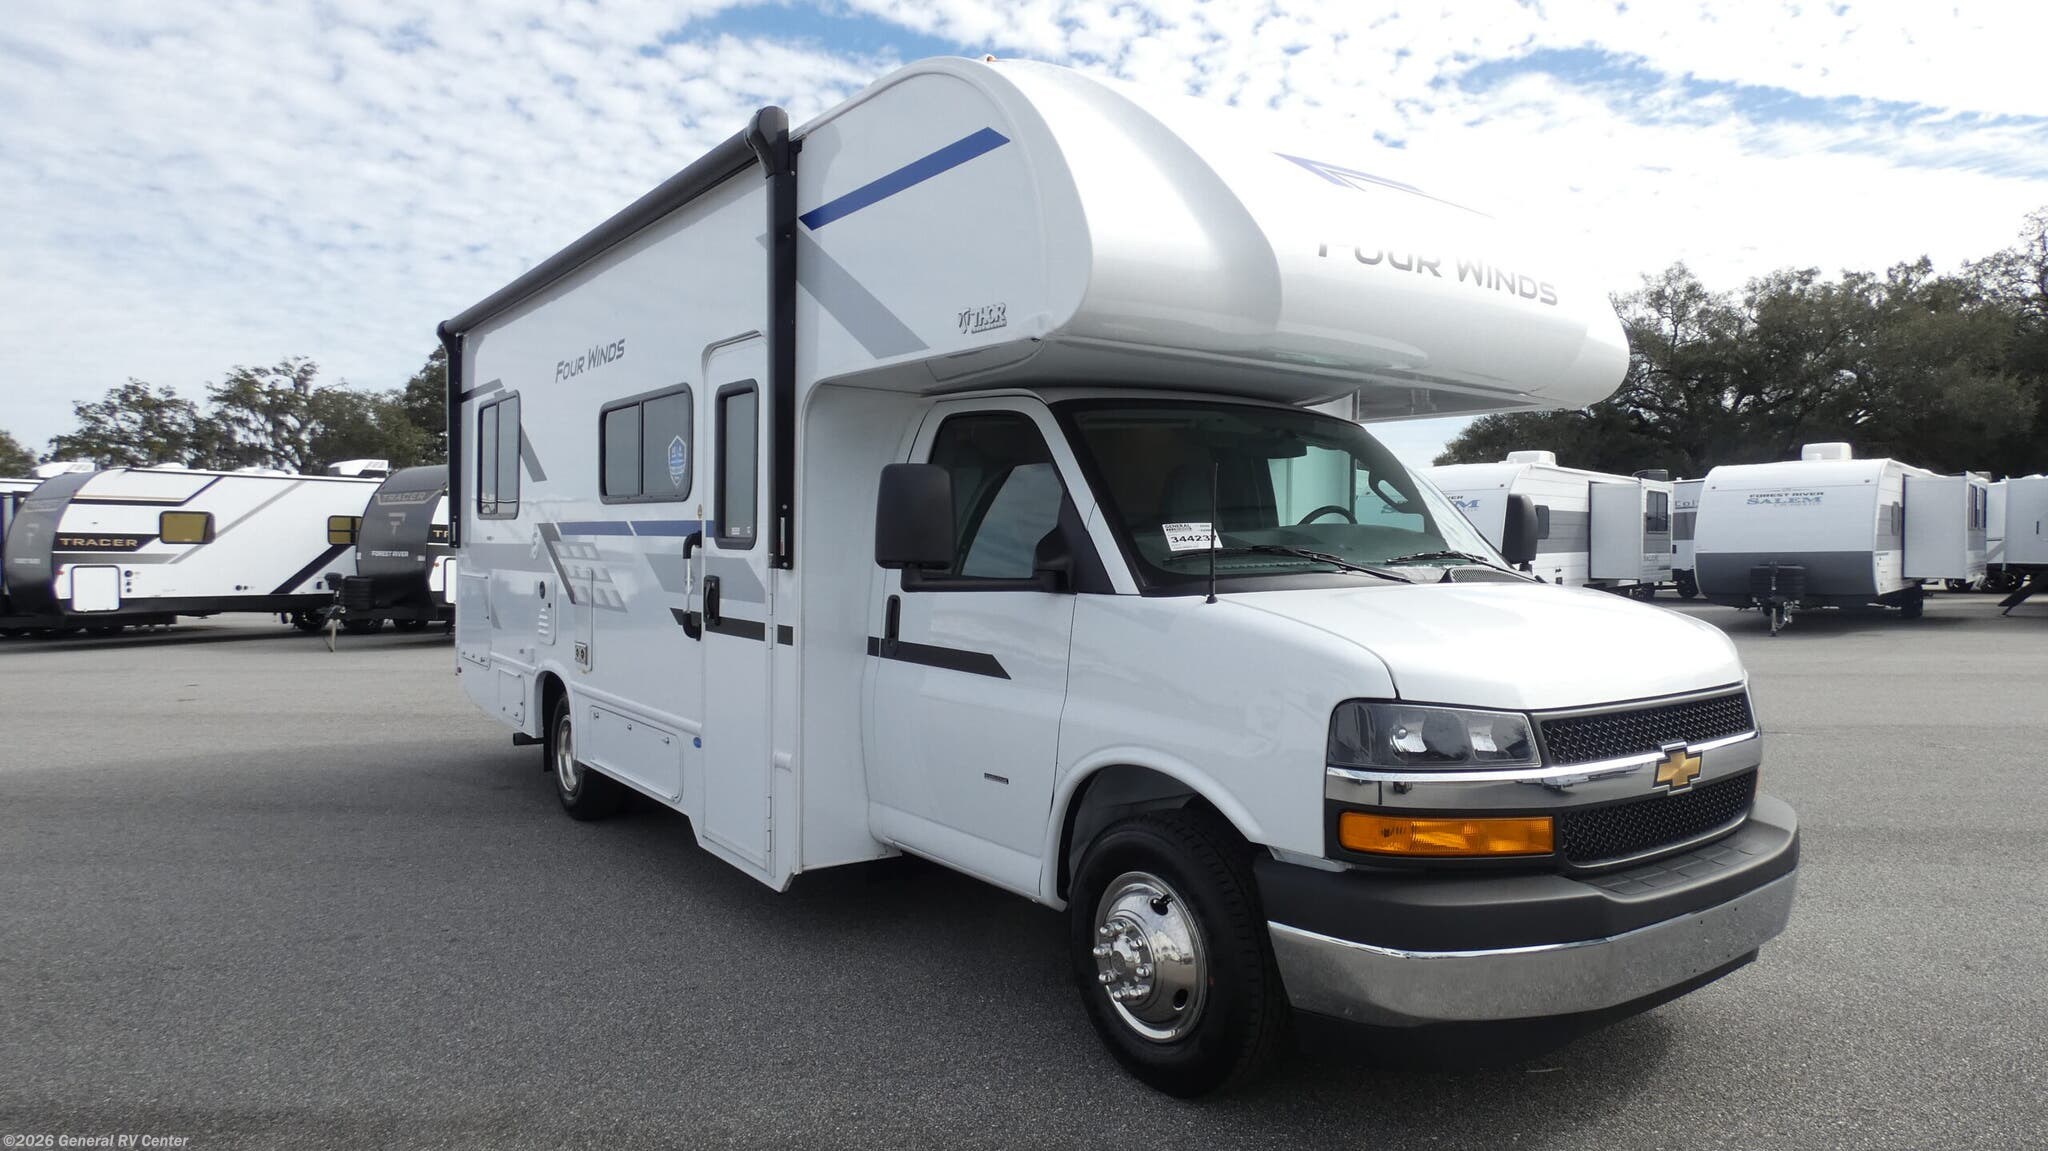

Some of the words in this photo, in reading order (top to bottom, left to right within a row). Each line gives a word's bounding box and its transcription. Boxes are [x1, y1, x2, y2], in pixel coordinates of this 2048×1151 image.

[1456, 256, 1558, 306] WINDS
[555, 360, 585, 384] FOUR
[587, 338, 625, 370] WINDS
[383, 492, 426, 501] TRACER
[1747, 497, 1822, 505] SALEM
[60, 538, 138, 547] TRACER
